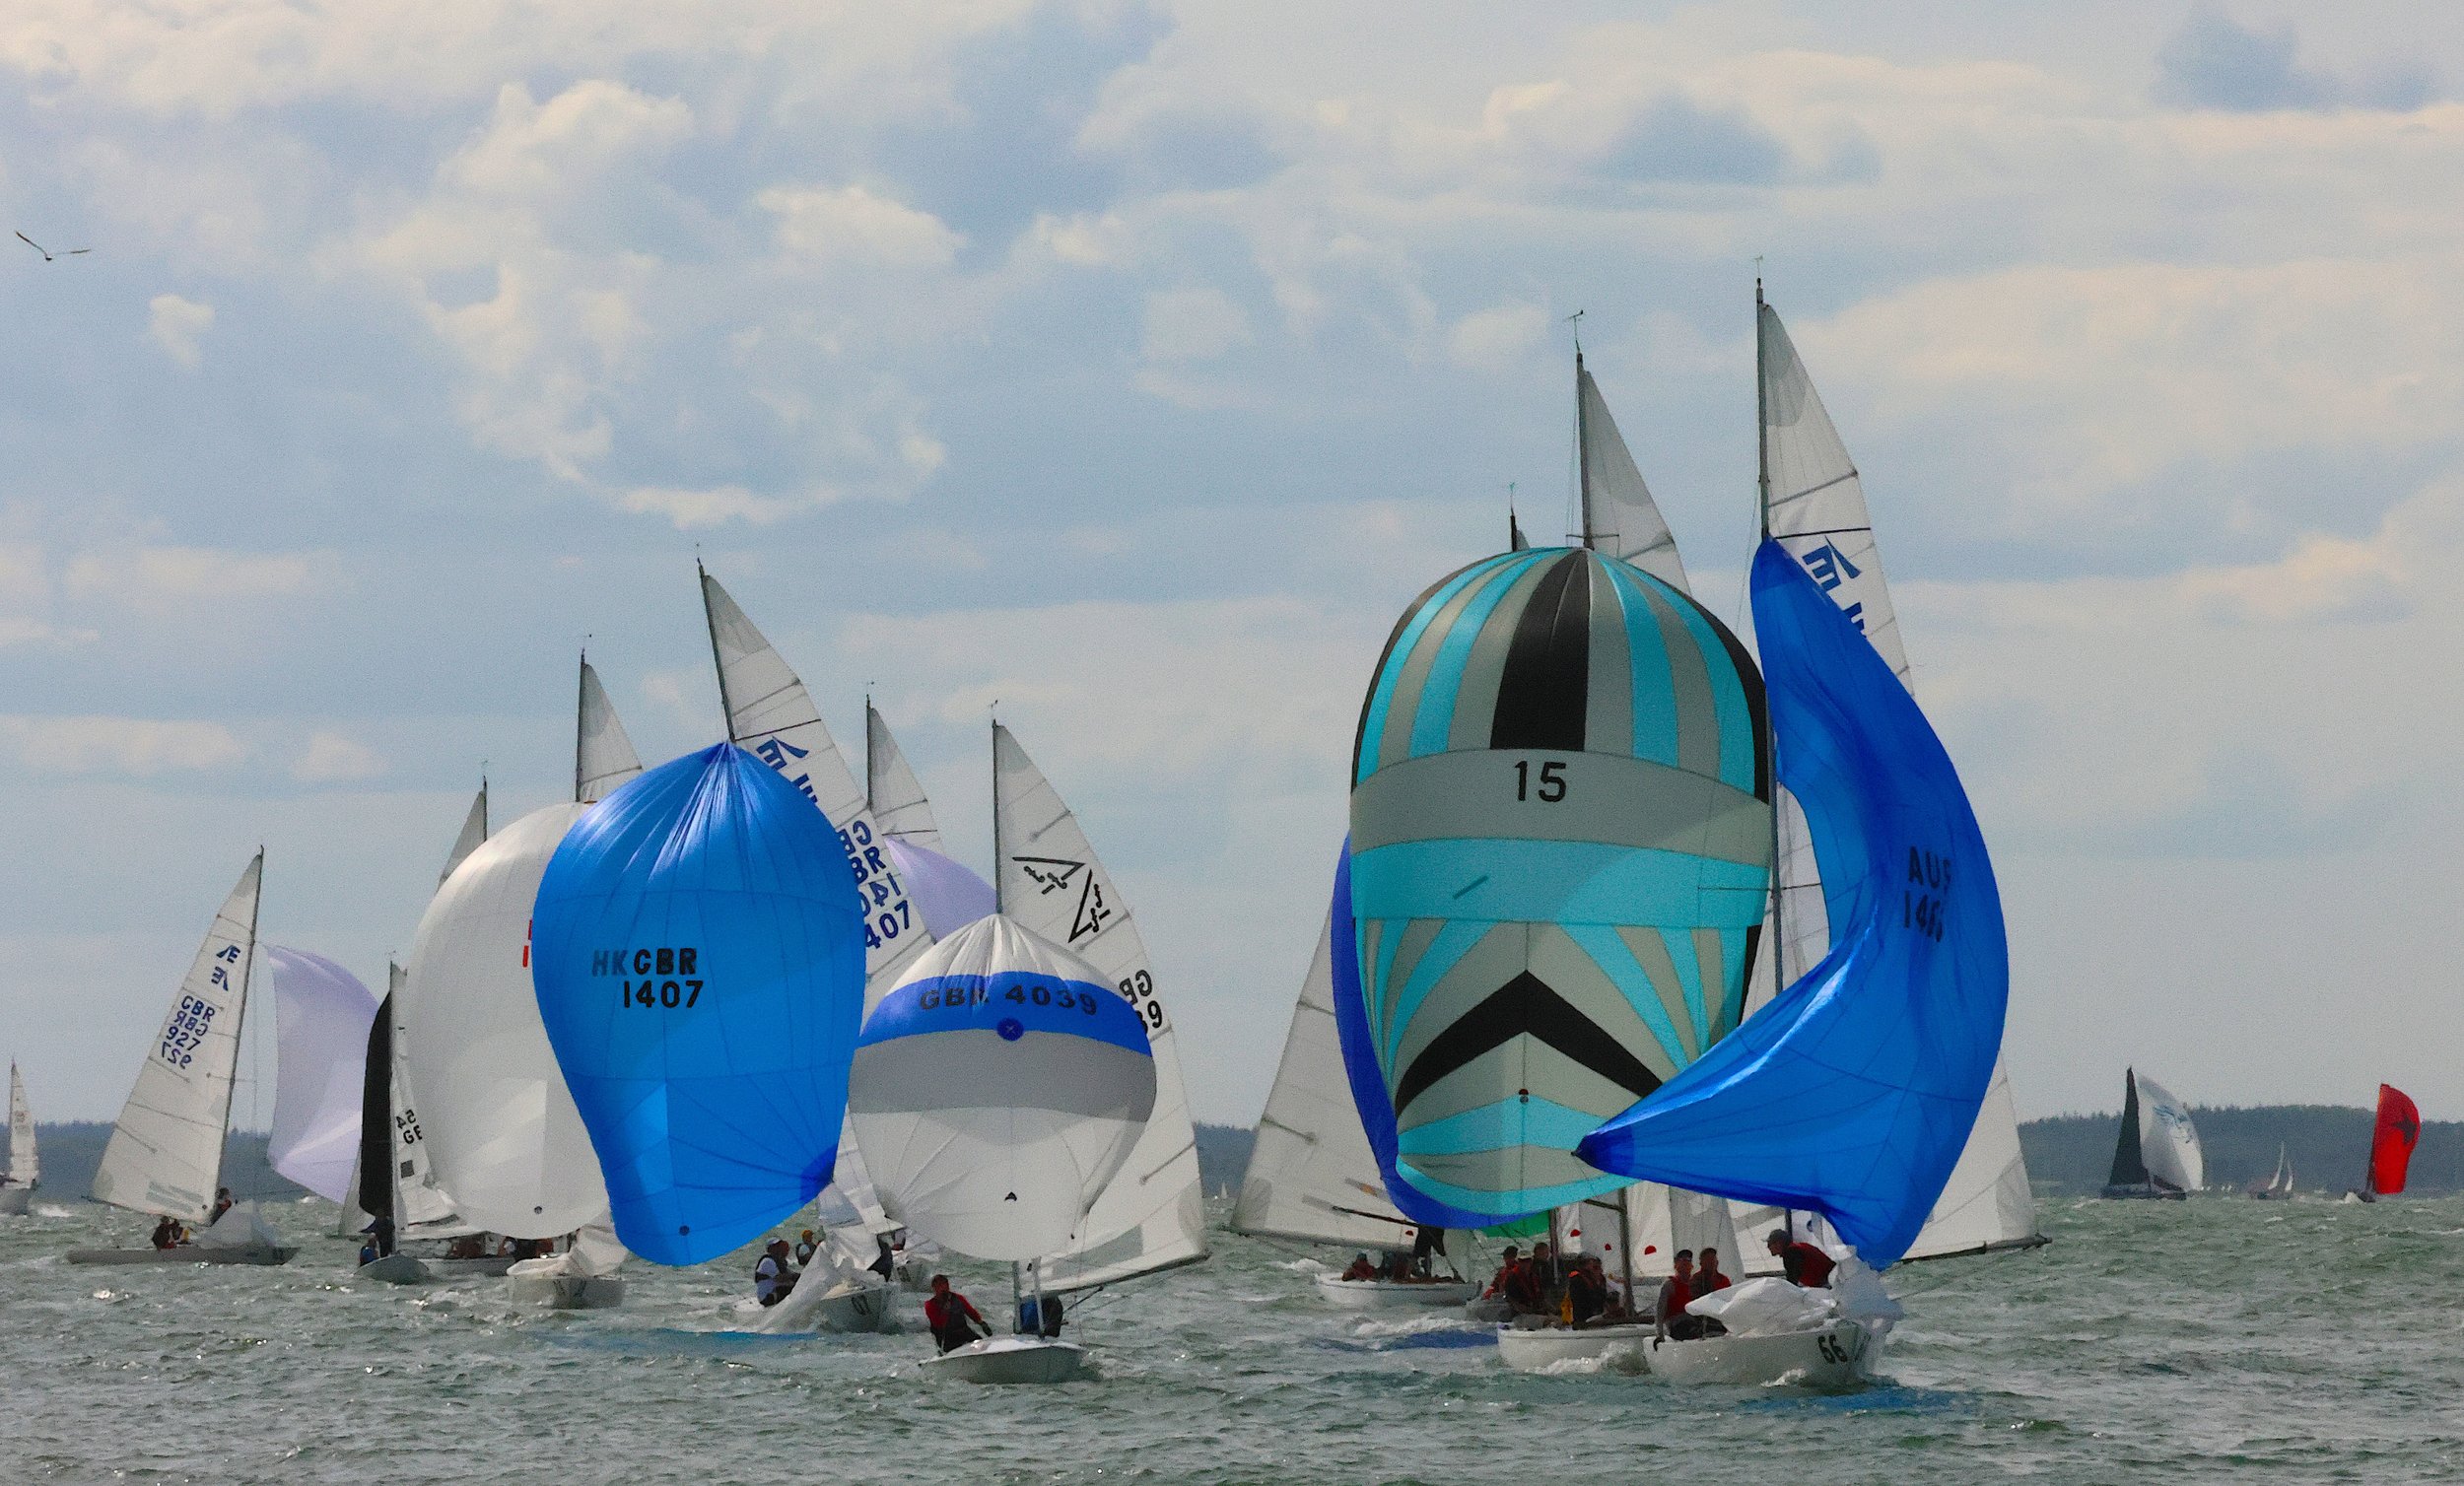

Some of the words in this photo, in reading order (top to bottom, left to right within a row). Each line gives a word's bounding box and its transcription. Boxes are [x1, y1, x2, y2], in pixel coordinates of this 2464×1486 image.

[1515, 761, 1566, 802] 15
[849, 846, 886, 884] BR
[864, 900, 910, 949] 407
[181, 995, 215, 1022] GBR
[624, 980, 704, 1008] 1407
[1005, 984, 1097, 1016] 4039
[167, 1026, 201, 1050] 927
[1818, 1335, 1848, 1364] 66
